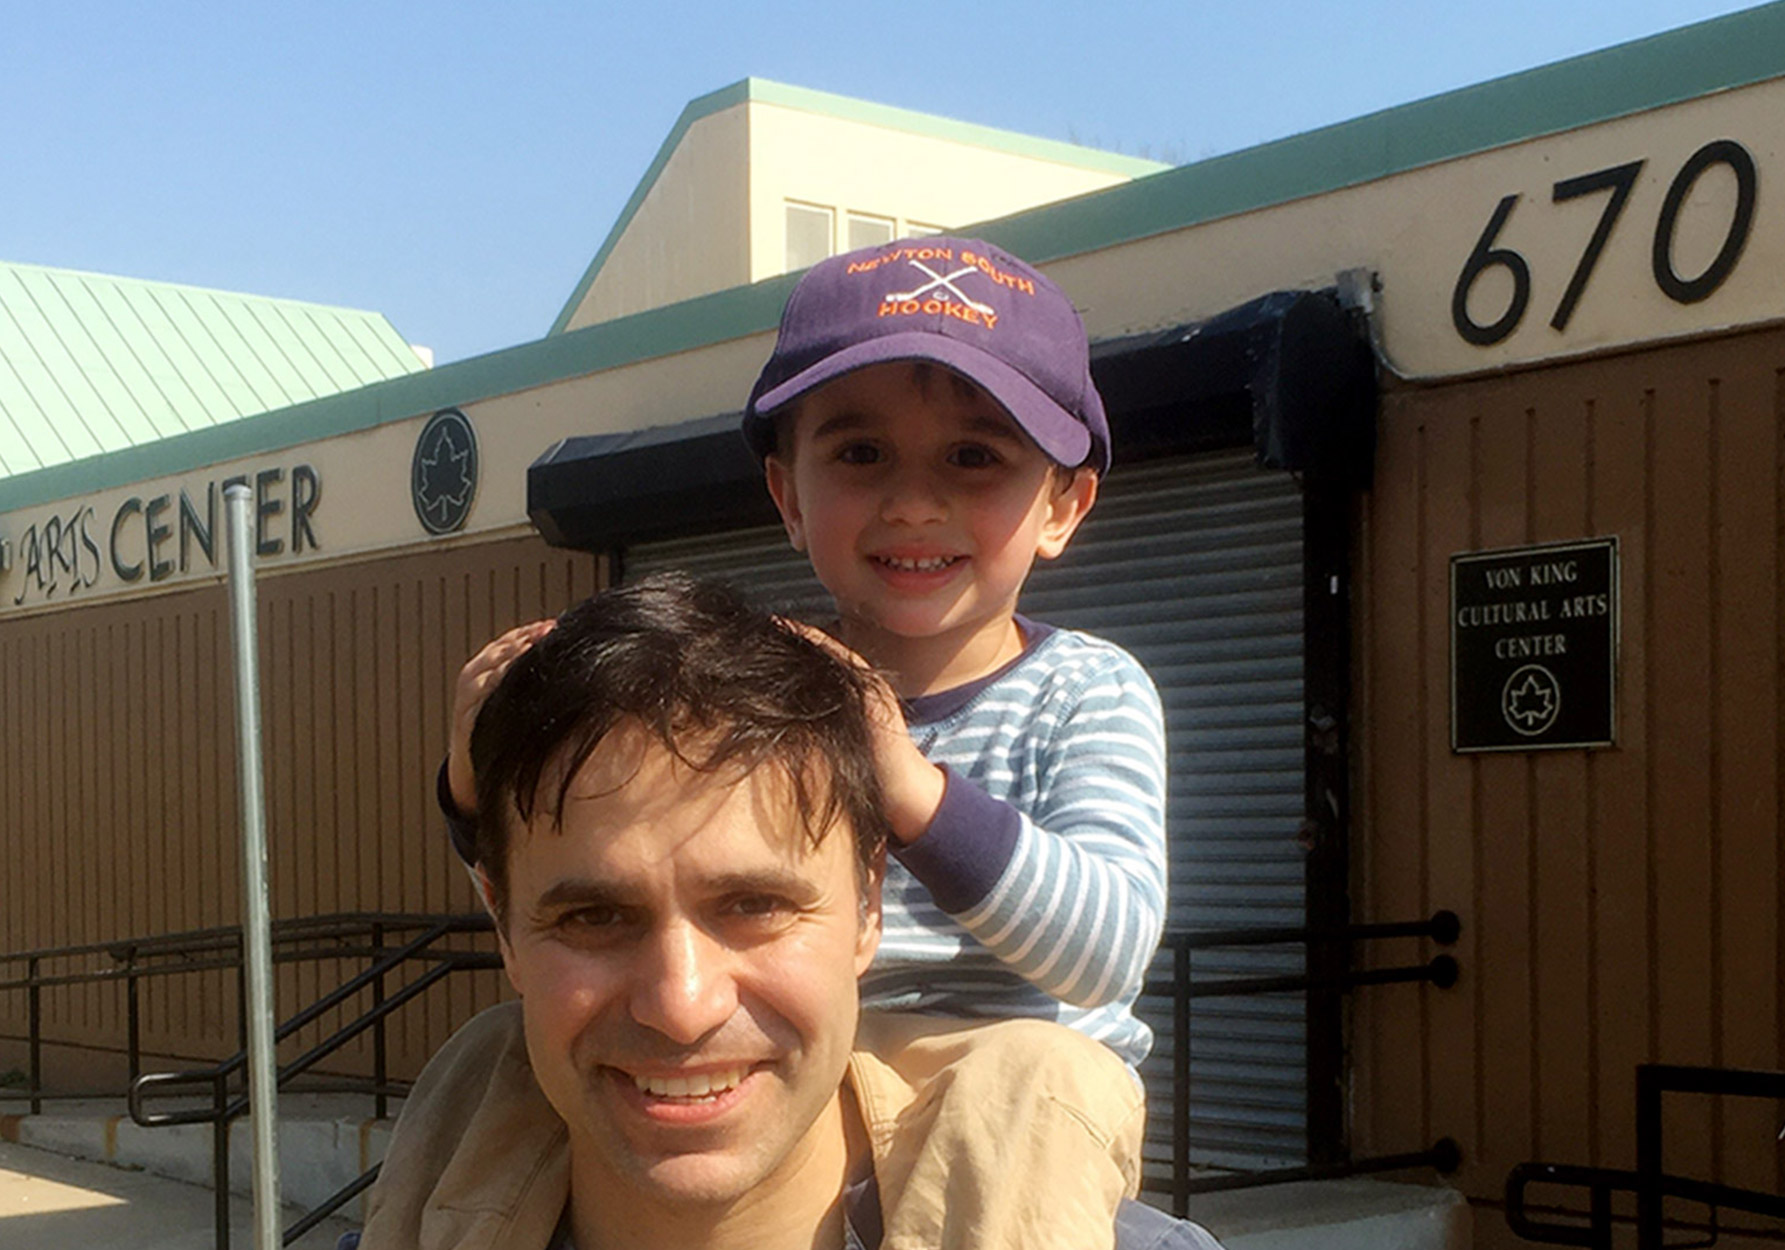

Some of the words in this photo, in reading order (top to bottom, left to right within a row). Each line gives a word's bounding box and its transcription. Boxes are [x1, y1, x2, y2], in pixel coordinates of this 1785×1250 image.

[1452, 139, 1757, 347] 670
[847, 248, 953, 274] NEWTON
[960, 250, 1035, 296] SOUTH
[14, 504, 100, 605] ARTS
[1486, 567, 1522, 589] VON
[1530, 561, 1577, 585] KING
[1458, 600, 1551, 627] CULTURAL
[1560, 593, 1608, 618] ARTS
[1495, 633, 1567, 659] CENTER
